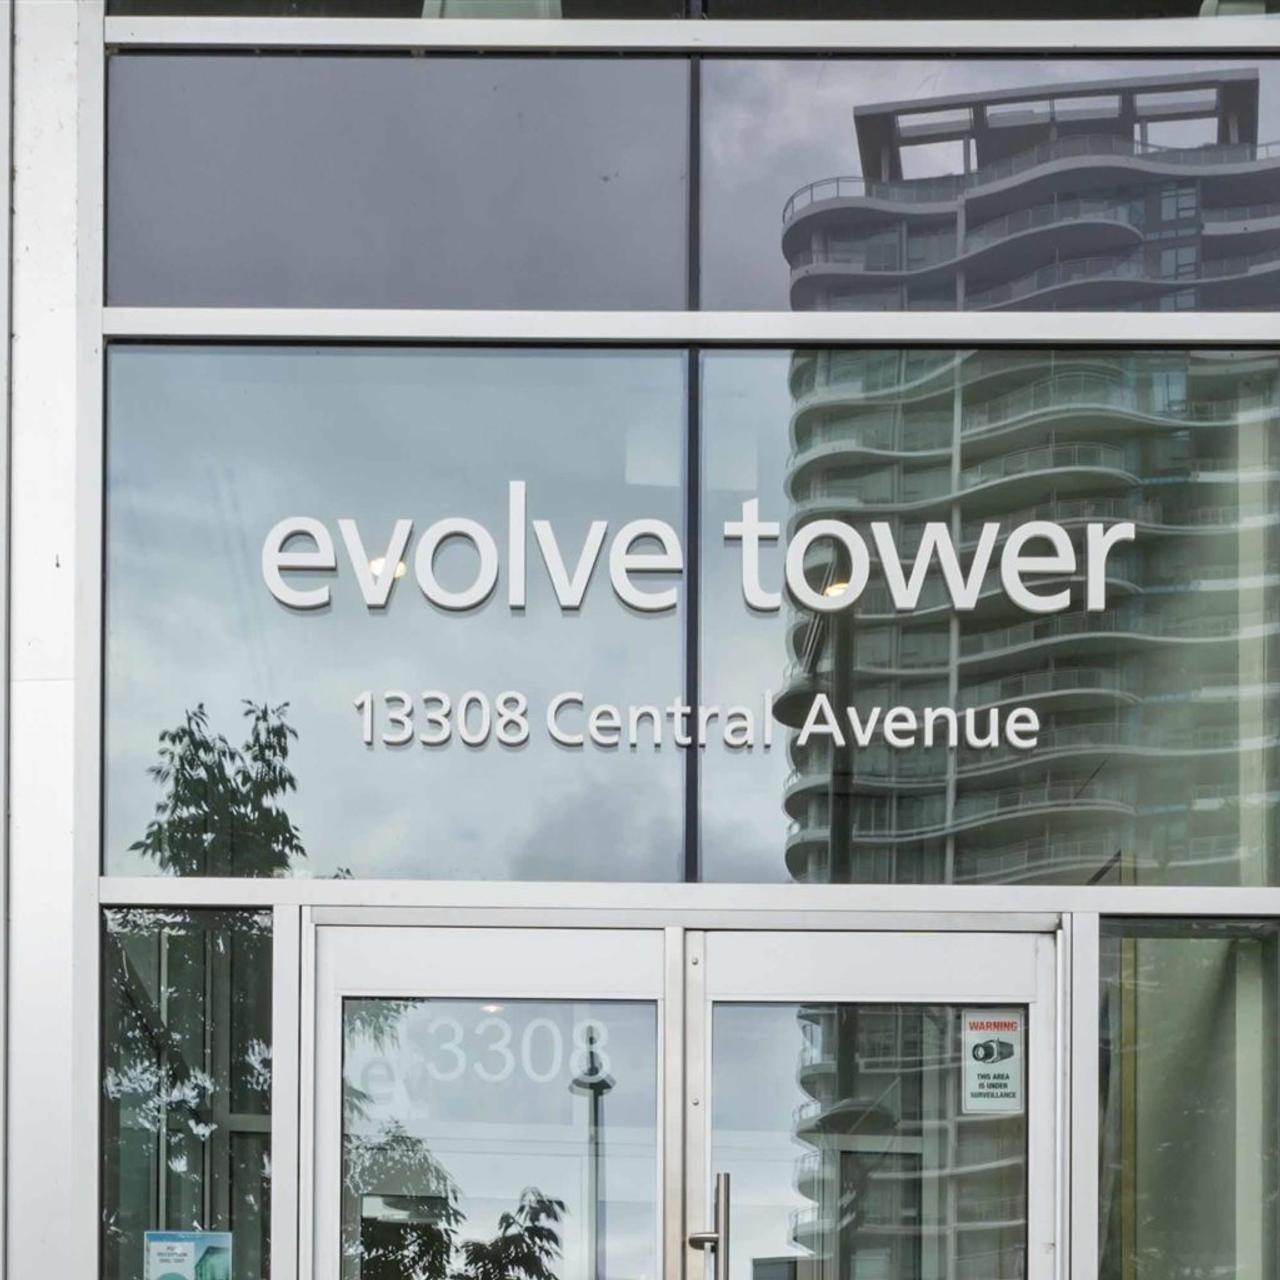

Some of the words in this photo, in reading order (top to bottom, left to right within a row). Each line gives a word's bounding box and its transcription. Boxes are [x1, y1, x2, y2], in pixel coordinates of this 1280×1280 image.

[261, 479, 685, 612] evolve
[723, 498, 1137, 613] tower
[352, 690, 530, 747] 13308
[546, 690, 772, 749] Central
[797, 693, 1041, 750] Avenue
[968, 1020, 1019, 1033] WARNING
